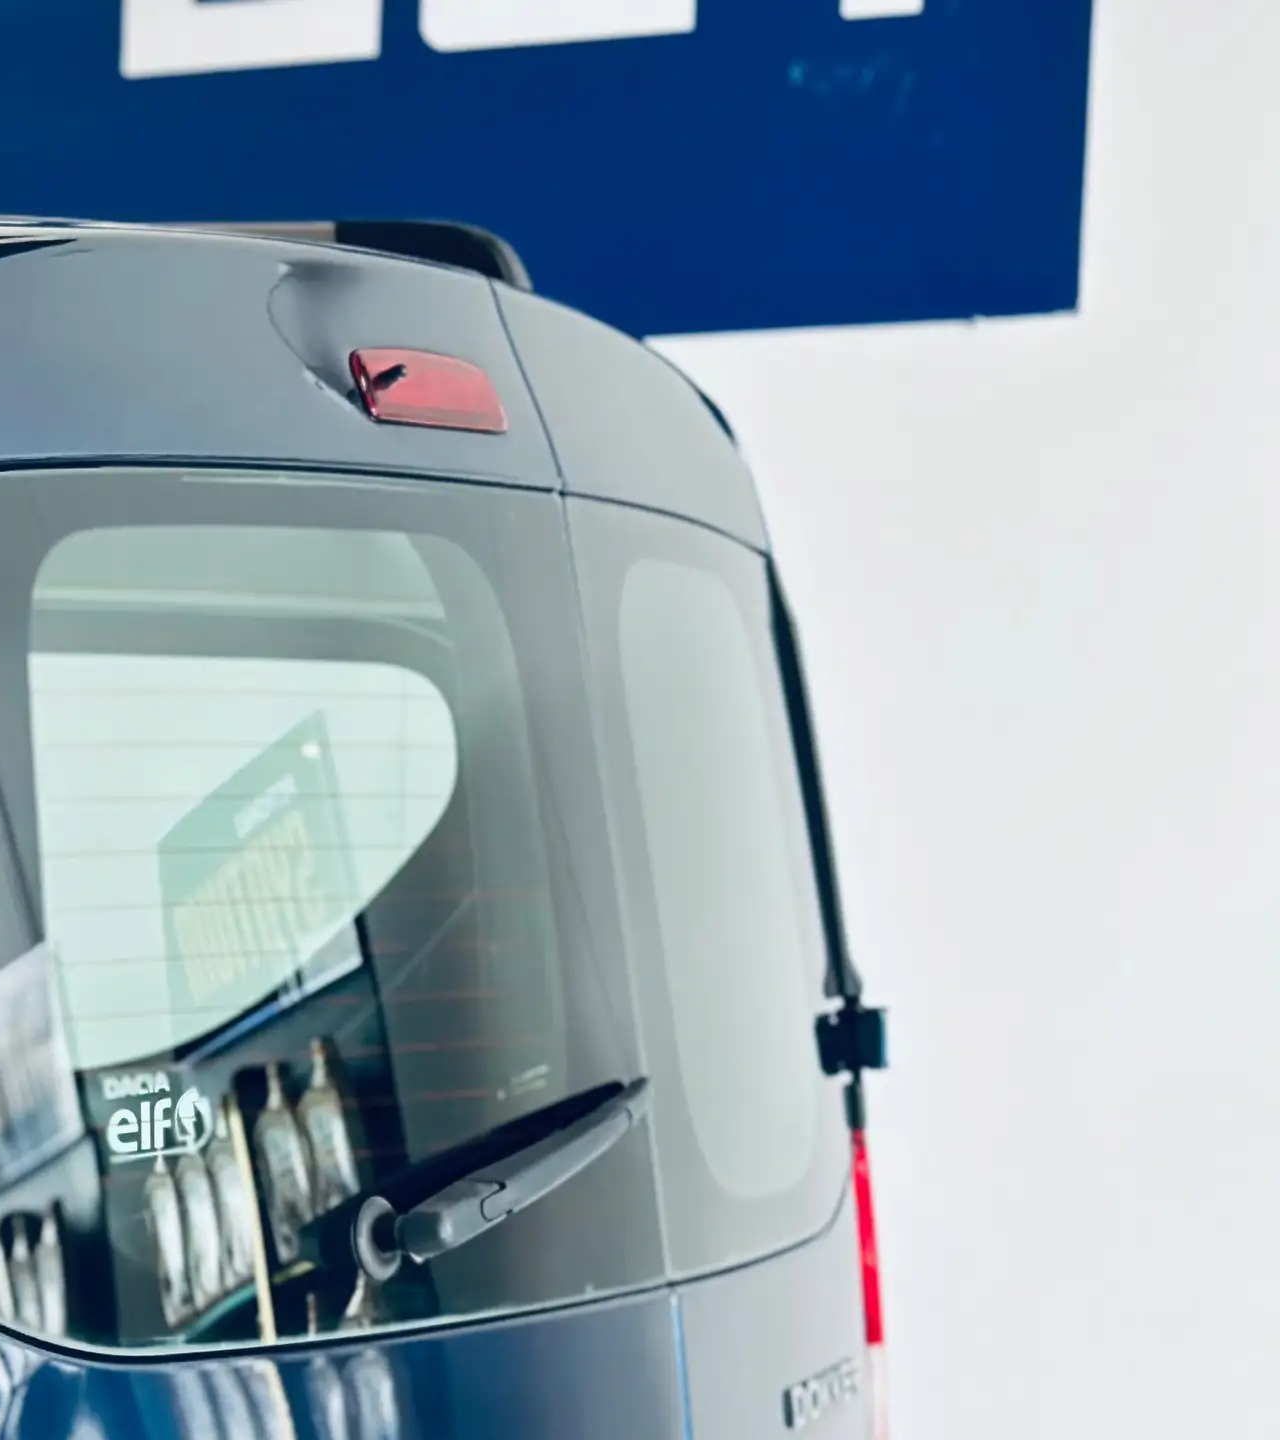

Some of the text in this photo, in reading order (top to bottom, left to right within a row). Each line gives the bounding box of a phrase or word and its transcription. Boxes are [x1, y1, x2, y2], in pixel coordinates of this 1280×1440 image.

[103, 1071, 170, 1100] DACIA
[107, 1098, 172, 1154] elf
[781, 1355, 863, 1430] DOKKE
